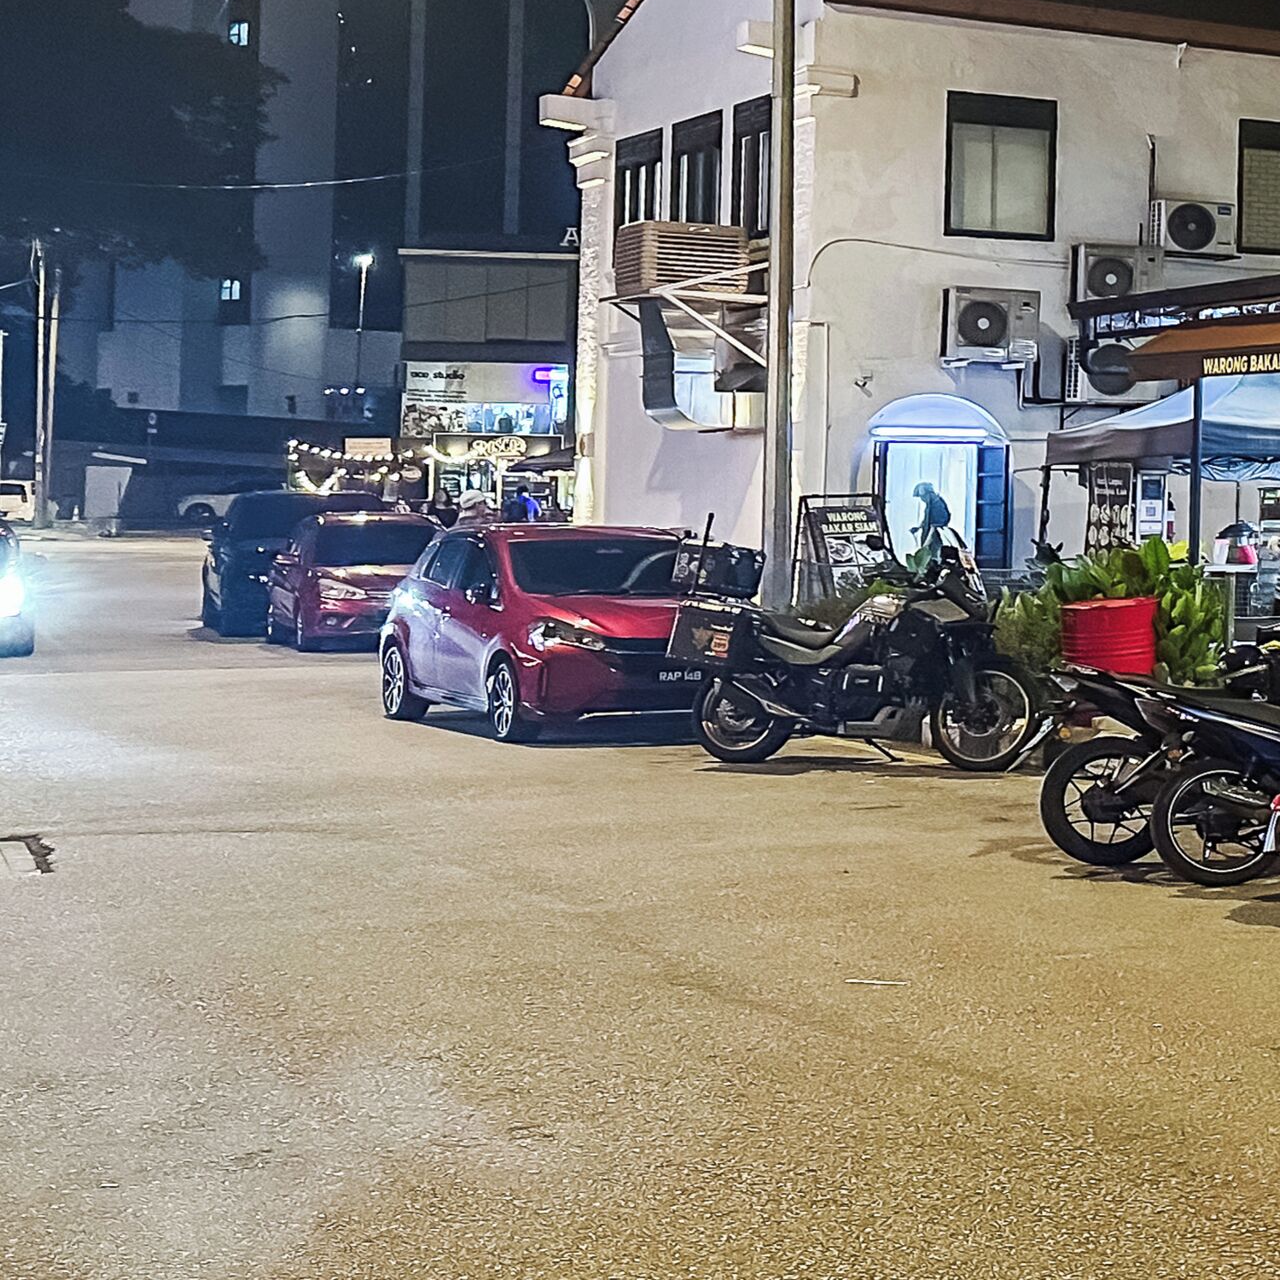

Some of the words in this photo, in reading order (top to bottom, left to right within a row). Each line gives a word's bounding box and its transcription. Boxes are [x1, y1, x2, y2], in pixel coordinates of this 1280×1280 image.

[1203, 355, 1249, 375] WARONG
[826, 511, 868, 522] WARONG
[821, 522, 854, 534] BAKAR
[854, 521, 878, 532] SIAM
[659, 671, 682, 681] RAP
